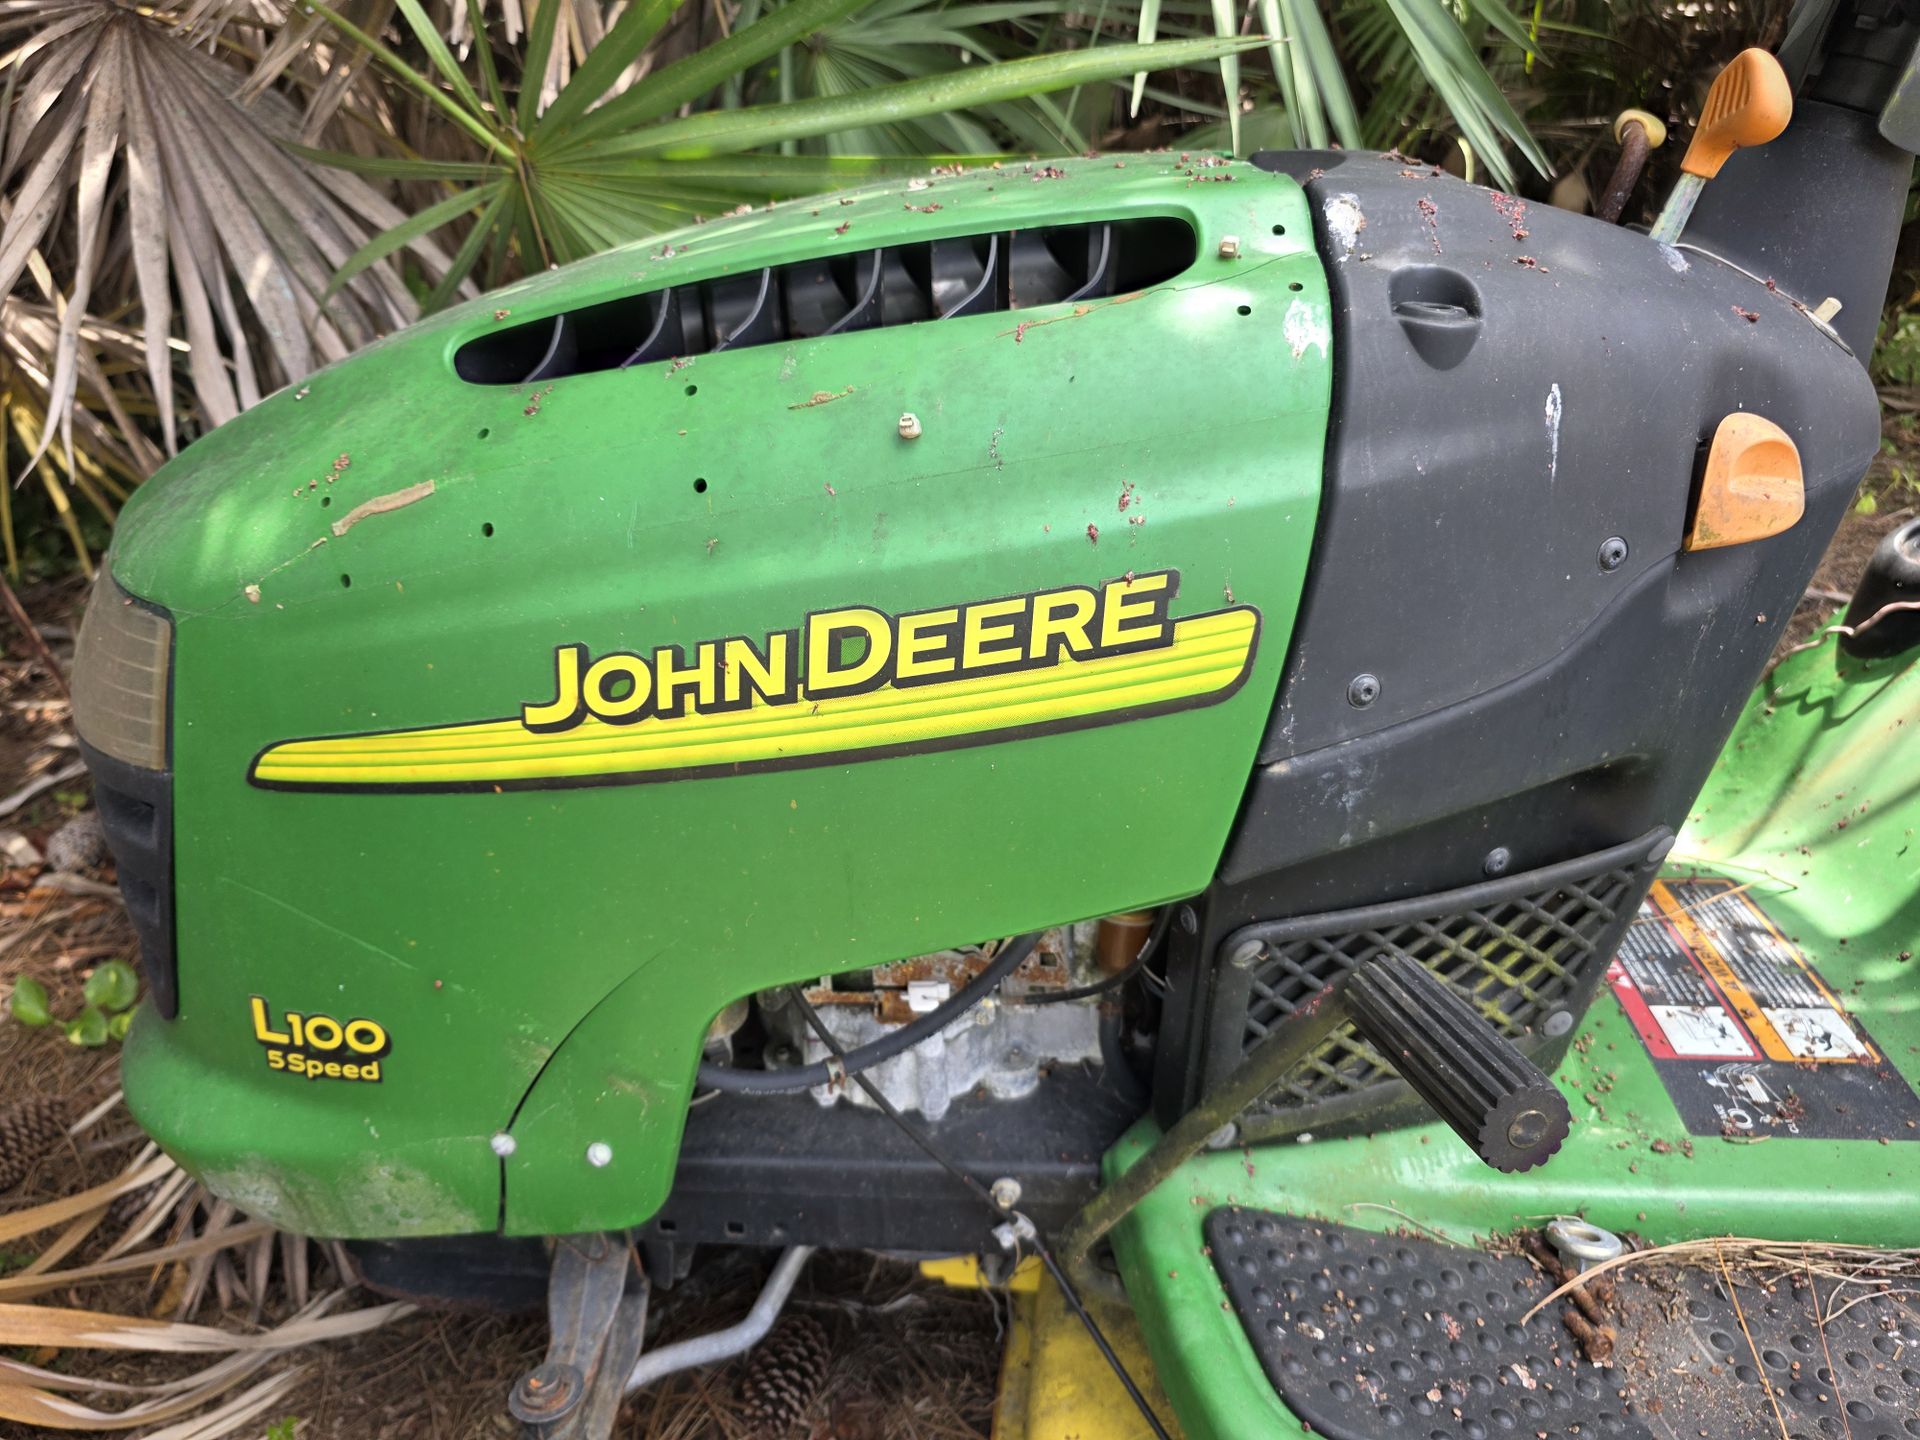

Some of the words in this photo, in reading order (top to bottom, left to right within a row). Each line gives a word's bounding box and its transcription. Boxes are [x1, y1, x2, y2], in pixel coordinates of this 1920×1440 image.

[525, 633, 788, 726] JOHN
[808, 573, 1169, 692] DEERE
[251, 997, 387, 1054] L100
